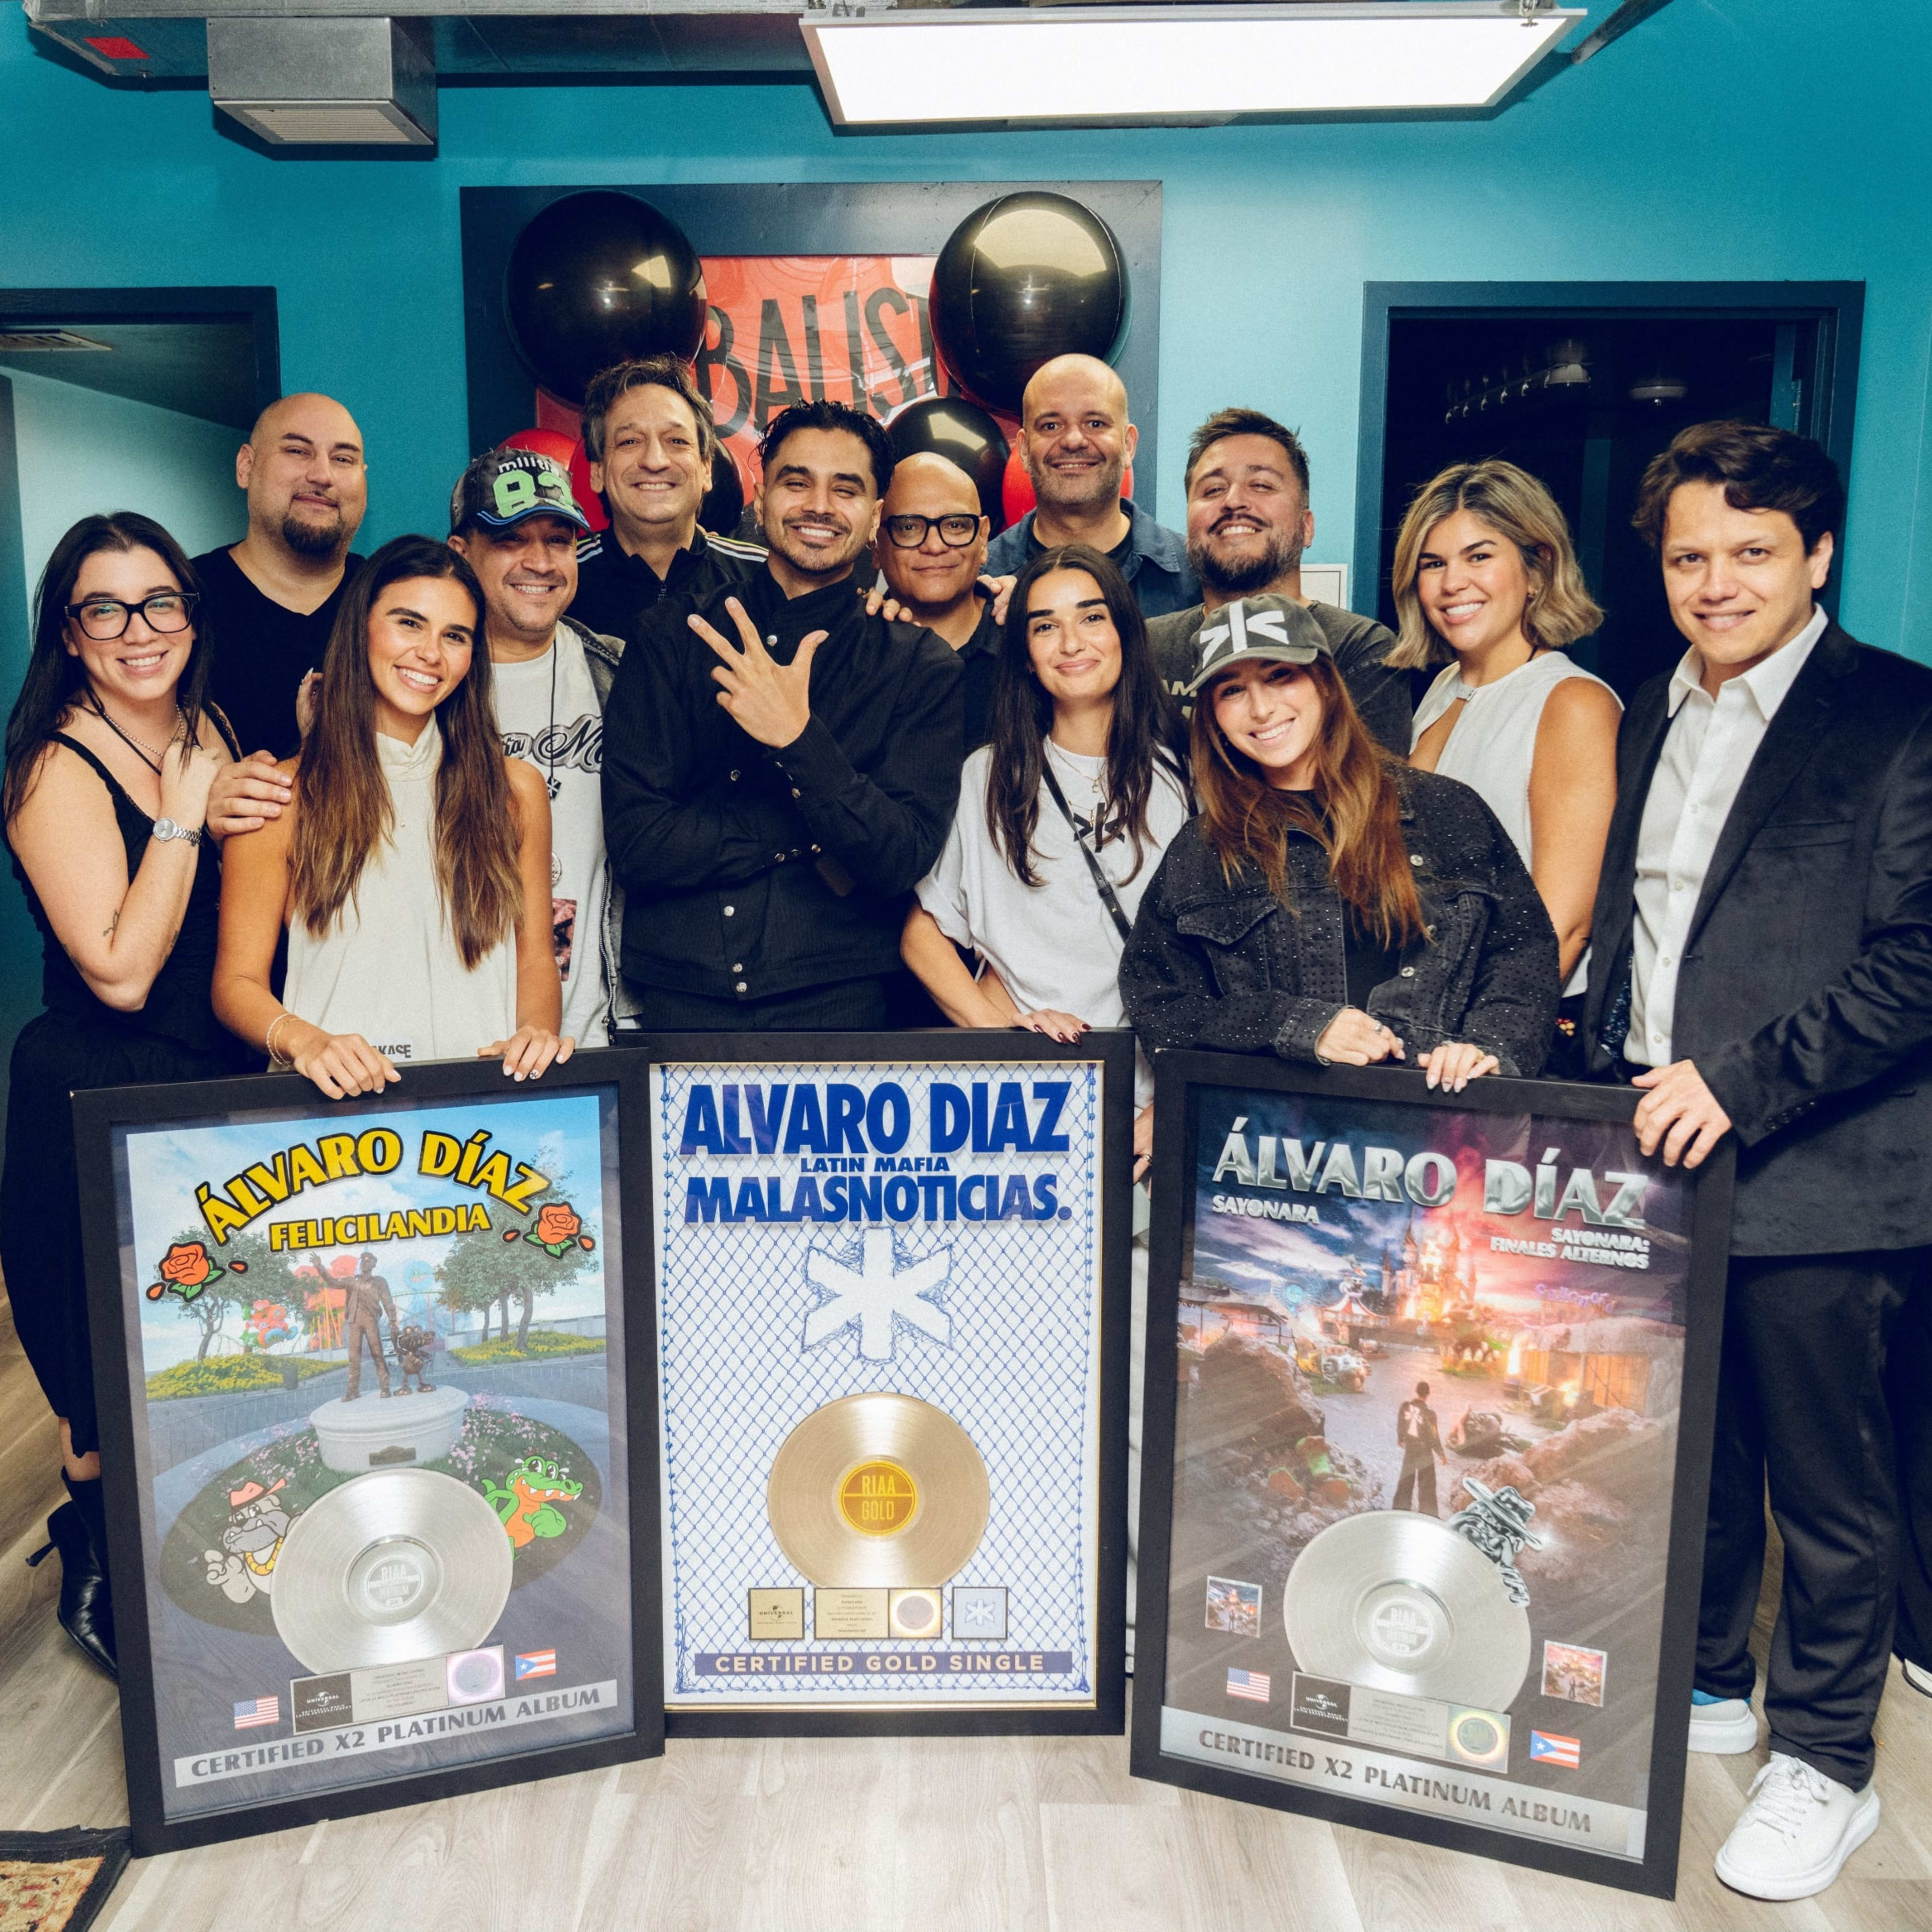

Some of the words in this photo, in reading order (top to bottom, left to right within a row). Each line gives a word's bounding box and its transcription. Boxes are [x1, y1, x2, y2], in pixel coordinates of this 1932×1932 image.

[680, 1082, 910, 1155] ALVARO
[929, 1082, 1072, 1153] DIAZ
[800, 1157, 865, 1173] LATIN
[874, 1157, 950, 1172] MAFIA
[1212, 1116, 1458, 1207] ÁLVARO
[1483, 1148, 1651, 1230] DÍAZ
[194, 1127, 403, 1246] ÁLVARO
[418, 1129, 552, 1215] DÍAZ
[1212, 1195, 1320, 1224] SAYONARA
[269, 1203, 491, 1252] FELICILANDIA
[1551, 1227, 1650, 1253] SAYONARA:
[1490, 1236, 1558, 1258] FINALES
[1560, 1245, 1650, 1269] ALTERNOS
[861, 1474, 896, 1496] RIAA
[862, 1500, 894, 1520] GOLD
[381, 1564, 407, 1581] RIAA
[715, 1656, 853, 1673] CERTIFIED
[866, 1655, 937, 1672] GOLD
[949, 1654, 1044, 1671] SINGLE
[306, 1695, 340, 1704] UNIVERSAL
[191, 1738, 325, 1778] CERTIFIED
[335, 1731, 365, 1751] X2
[378, 1705, 507, 1743] PLATINUM
[516, 1689, 600, 1718] ALBUM
[1198, 1730, 1315, 1770] CERTIFIED
[1325, 1756, 1353, 1779] X2
[1364, 1766, 1491, 1811] PLATINUM
[1502, 1798, 1591, 1833] ALBUM
